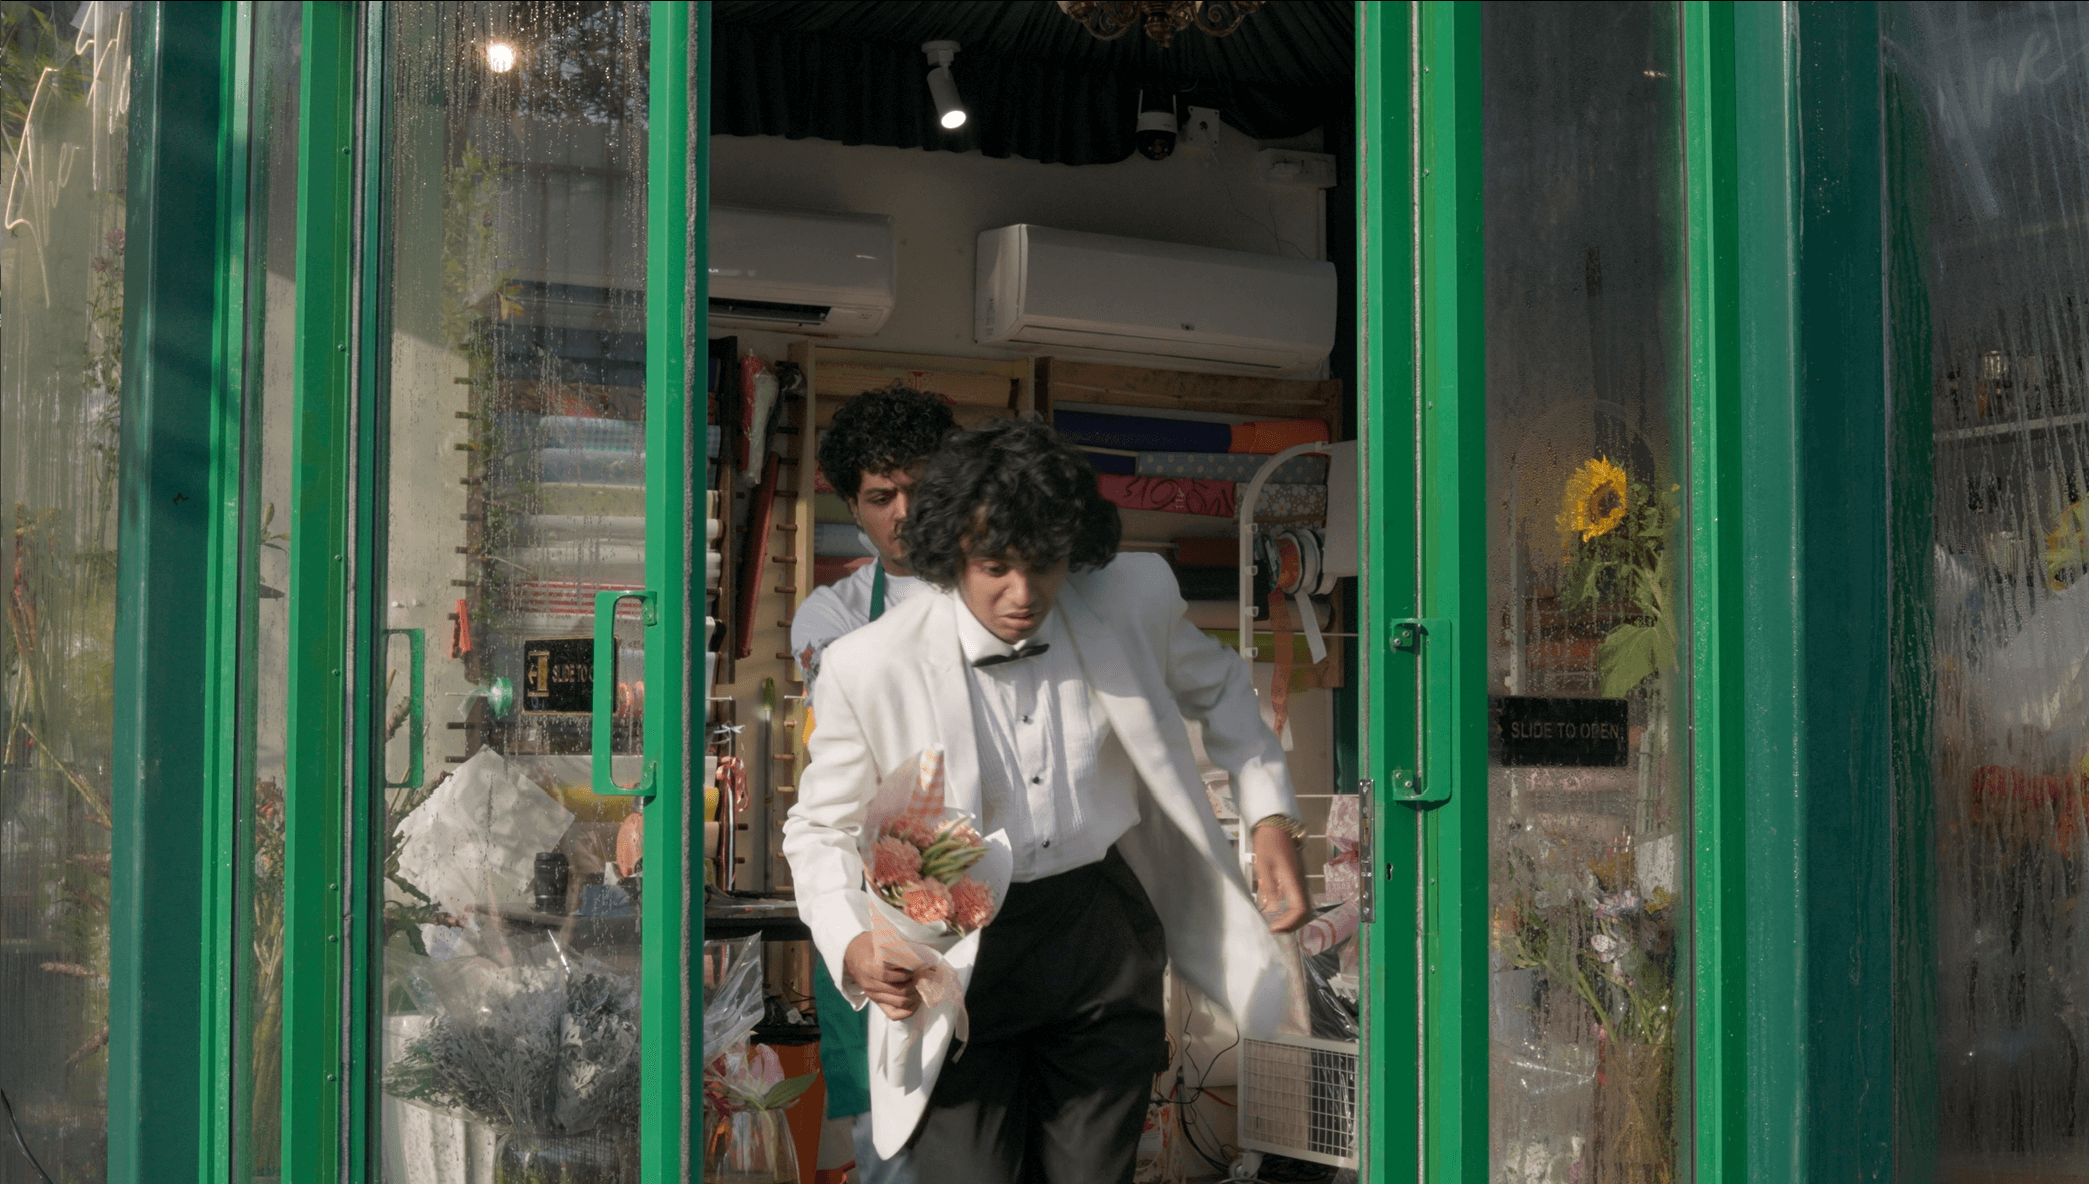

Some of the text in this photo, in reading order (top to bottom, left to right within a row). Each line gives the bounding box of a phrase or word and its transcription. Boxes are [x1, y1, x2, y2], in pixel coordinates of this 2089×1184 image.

[552, 664, 575, 682] SLIDE
[576, 664, 588, 682] TO
[1511, 721, 1619, 739] SLIDE TO OPEN
